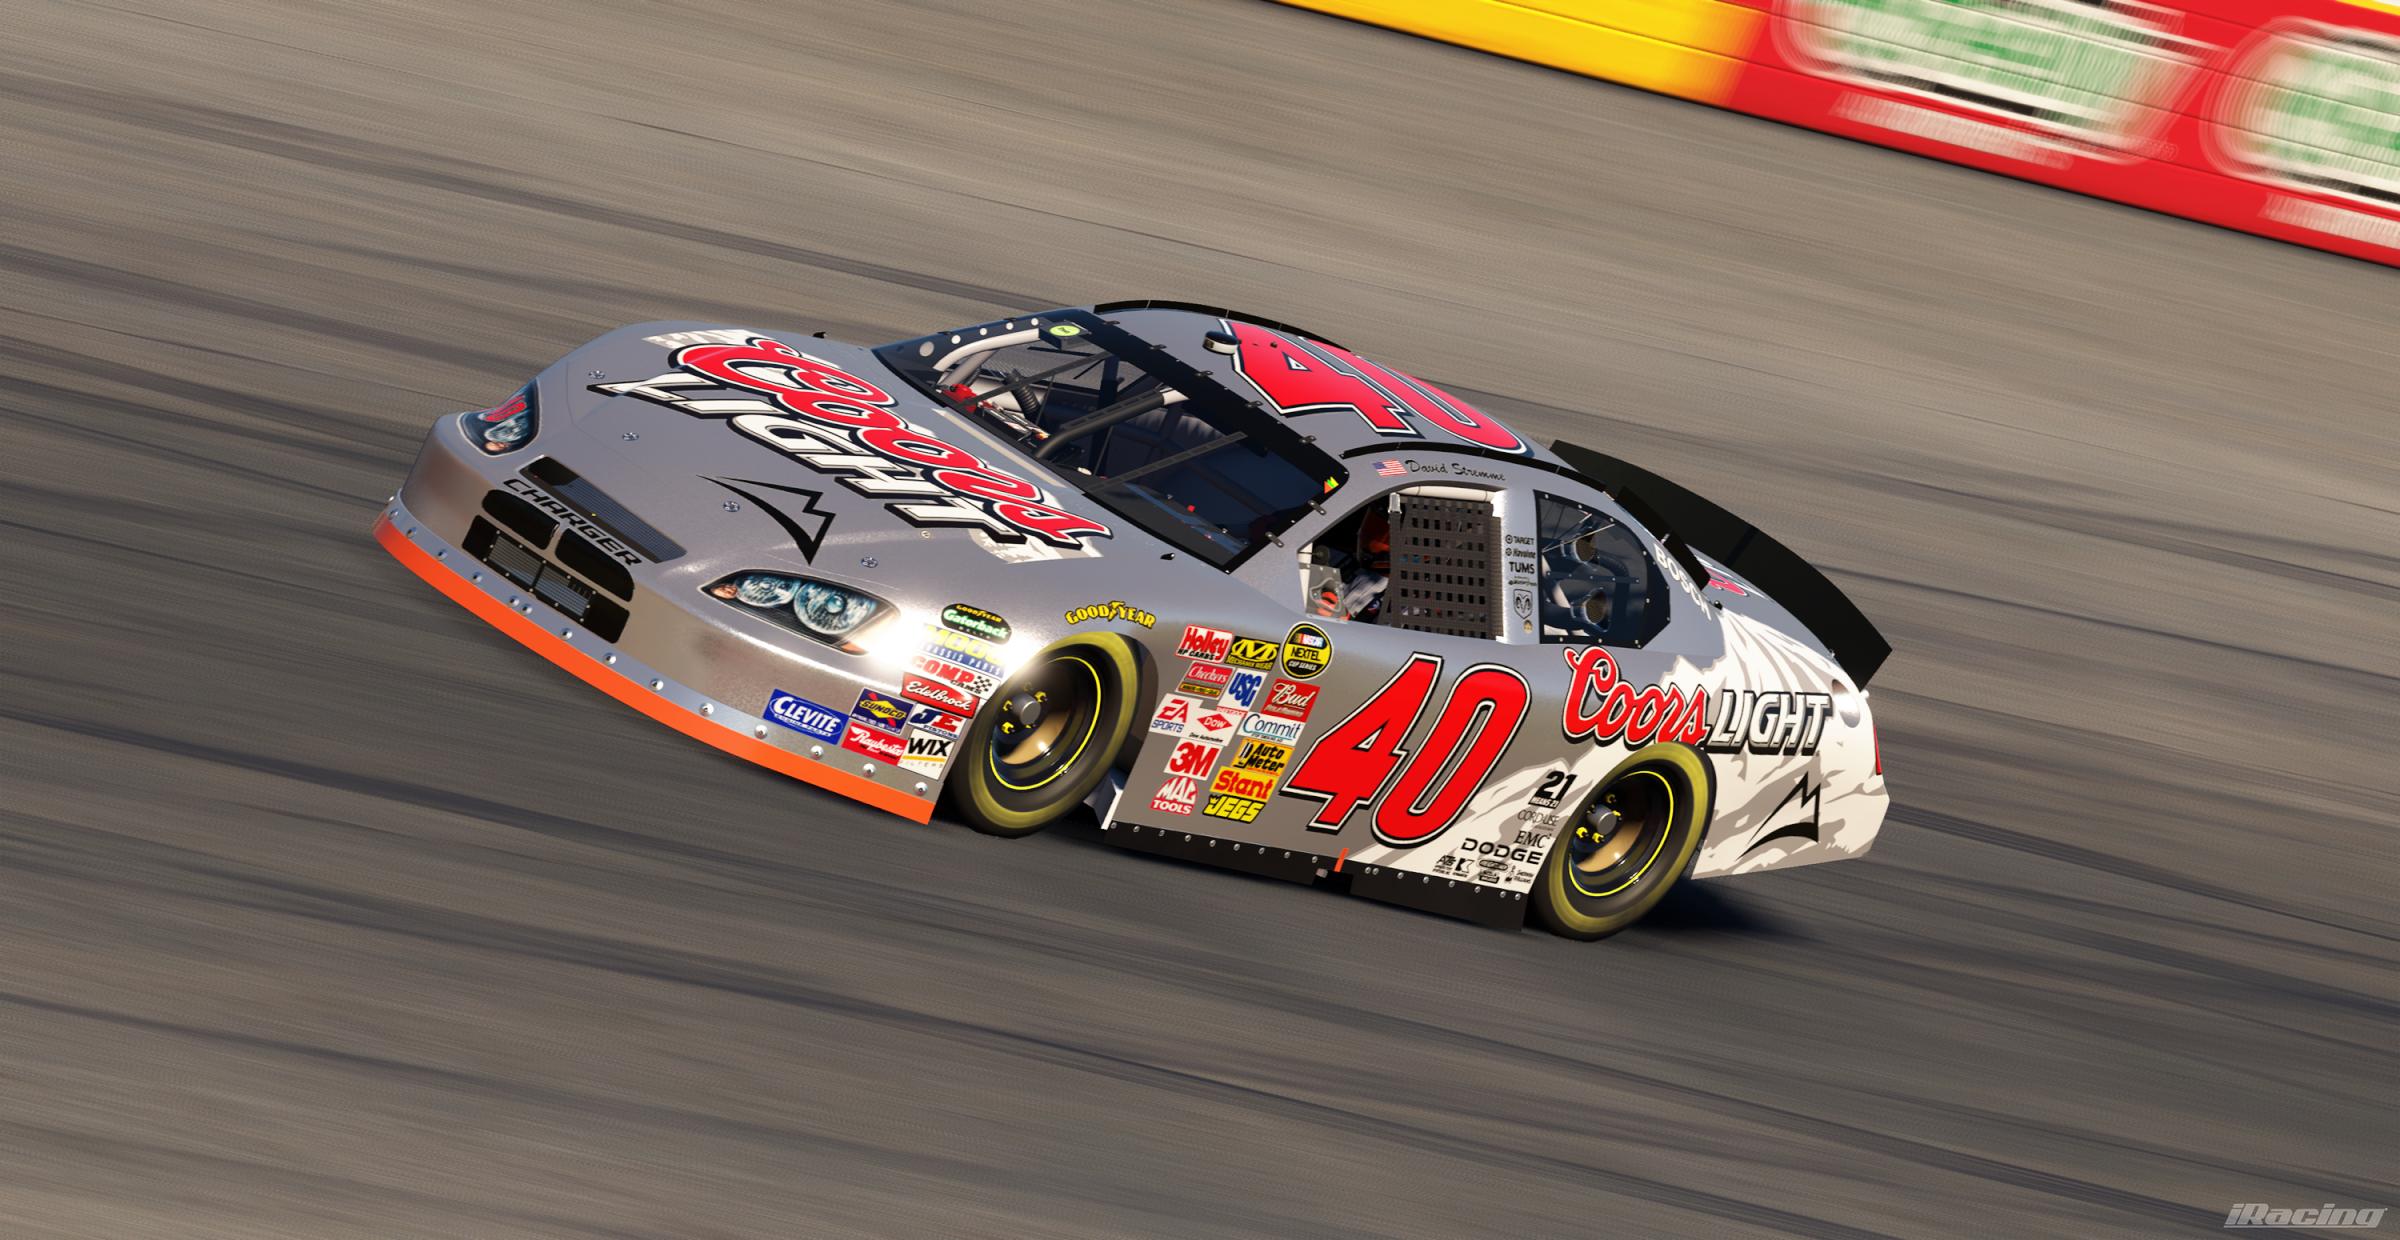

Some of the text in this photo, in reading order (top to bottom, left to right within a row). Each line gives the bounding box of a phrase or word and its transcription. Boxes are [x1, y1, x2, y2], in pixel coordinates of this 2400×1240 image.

[1218, 318, 1535, 458] 40
[668, 337, 1114, 549] Coors
[586, 373, 1027, 547] LIGHT
[1405, 460, 1448, 474] David
[503, 478, 643, 566] CHARGER
[1509, 561, 1535, 574] TUMS
[1653, 543, 1713, 621] BOSCH
[943, 609, 1009, 639] Gatorback
[1181, 627, 1229, 661] Holley
[1291, 647, 1321, 661] NEXTEL
[911, 655, 975, 685] COMP
[1288, 660, 1299, 668] CUP
[905, 680, 971, 712] Edelbrock
[950, 679, 983, 695] CAMS
[1274, 683, 1316, 707] Bud
[773, 696, 841, 733] CLEVITE
[860, 699, 907, 720] SUNOCO
[1157, 699, 1189, 723] EA
[1562, 646, 1834, 756] Coors LIGHT
[909, 708, 963, 733] JE
[923, 724, 959, 740] PISTONS
[1151, 719, 1185, 733] SPORTS
[1243, 713, 1301, 739] Commit
[908, 738, 951, 757] WIX
[1170, 742, 1219, 778] 3M
[1253, 743, 1284, 760] Auto
[1278, 651, 1532, 849] 40
[1247, 755, 1285, 772] Meter
[1155, 776, 1196, 804] MAC
[1215, 770, 1273, 799] Stant
[1535, 771, 1577, 800] 21
[1152, 800, 1193, 815] TOOLS
[1203, 795, 1267, 824] JEGS
[1461, 838, 1544, 865] DODGE
